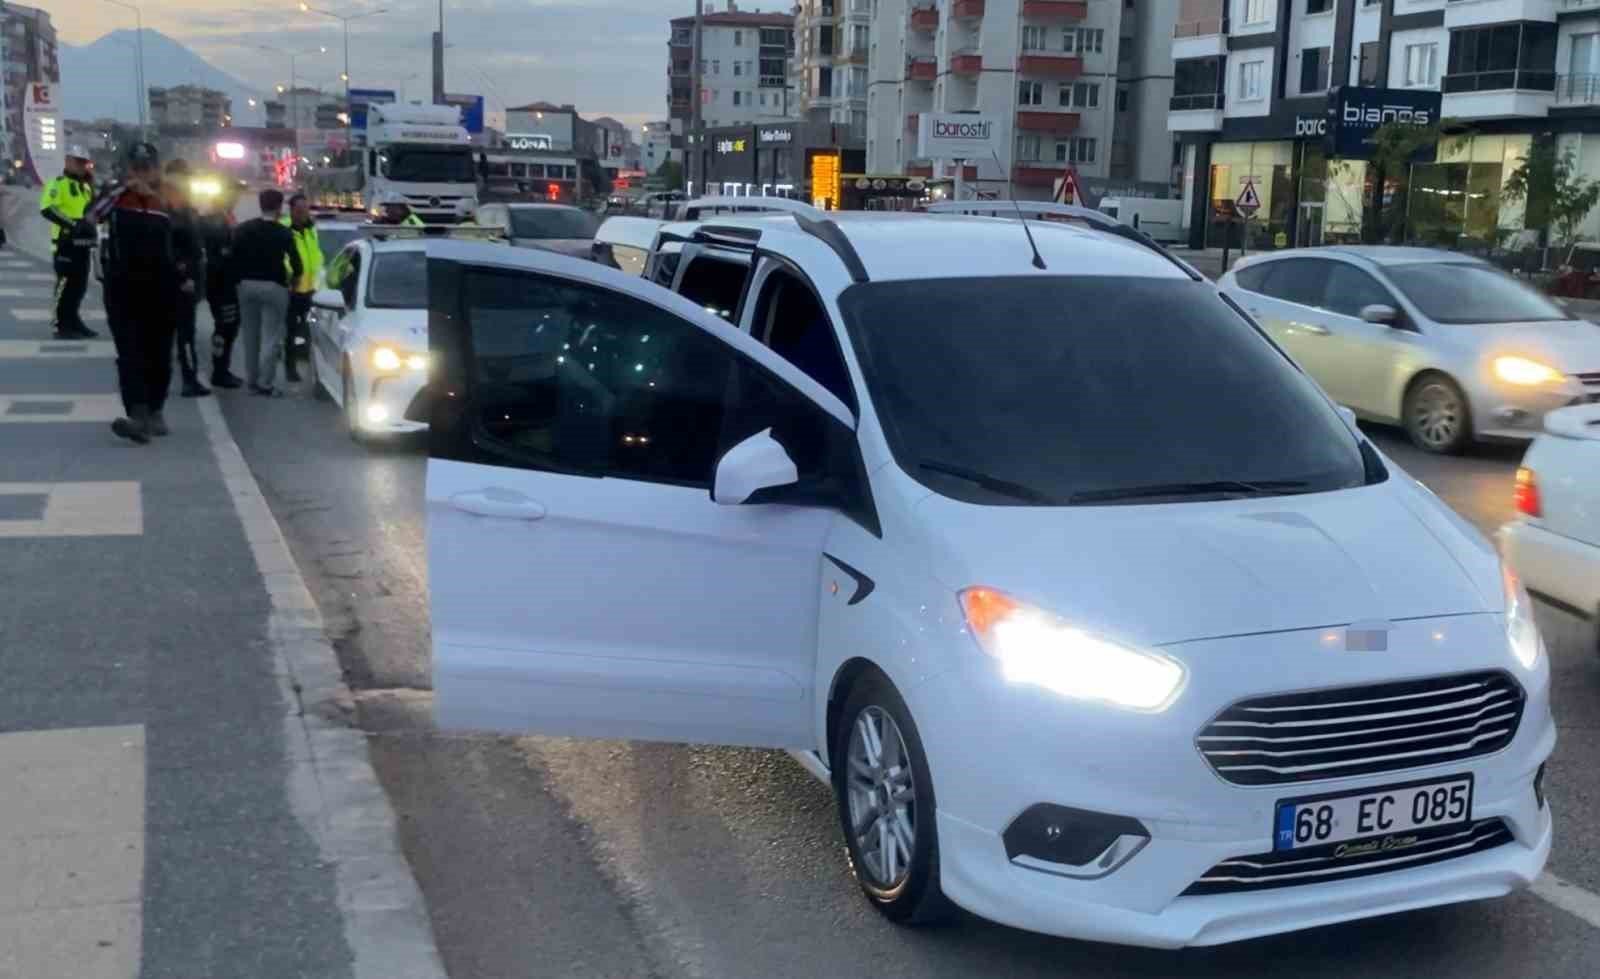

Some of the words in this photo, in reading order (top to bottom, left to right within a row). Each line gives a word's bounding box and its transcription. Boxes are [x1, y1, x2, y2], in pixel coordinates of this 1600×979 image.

[1296, 805, 1332, 842] 68
[1357, 796, 1395, 833] EC
[1412, 785, 1466, 824] 085
